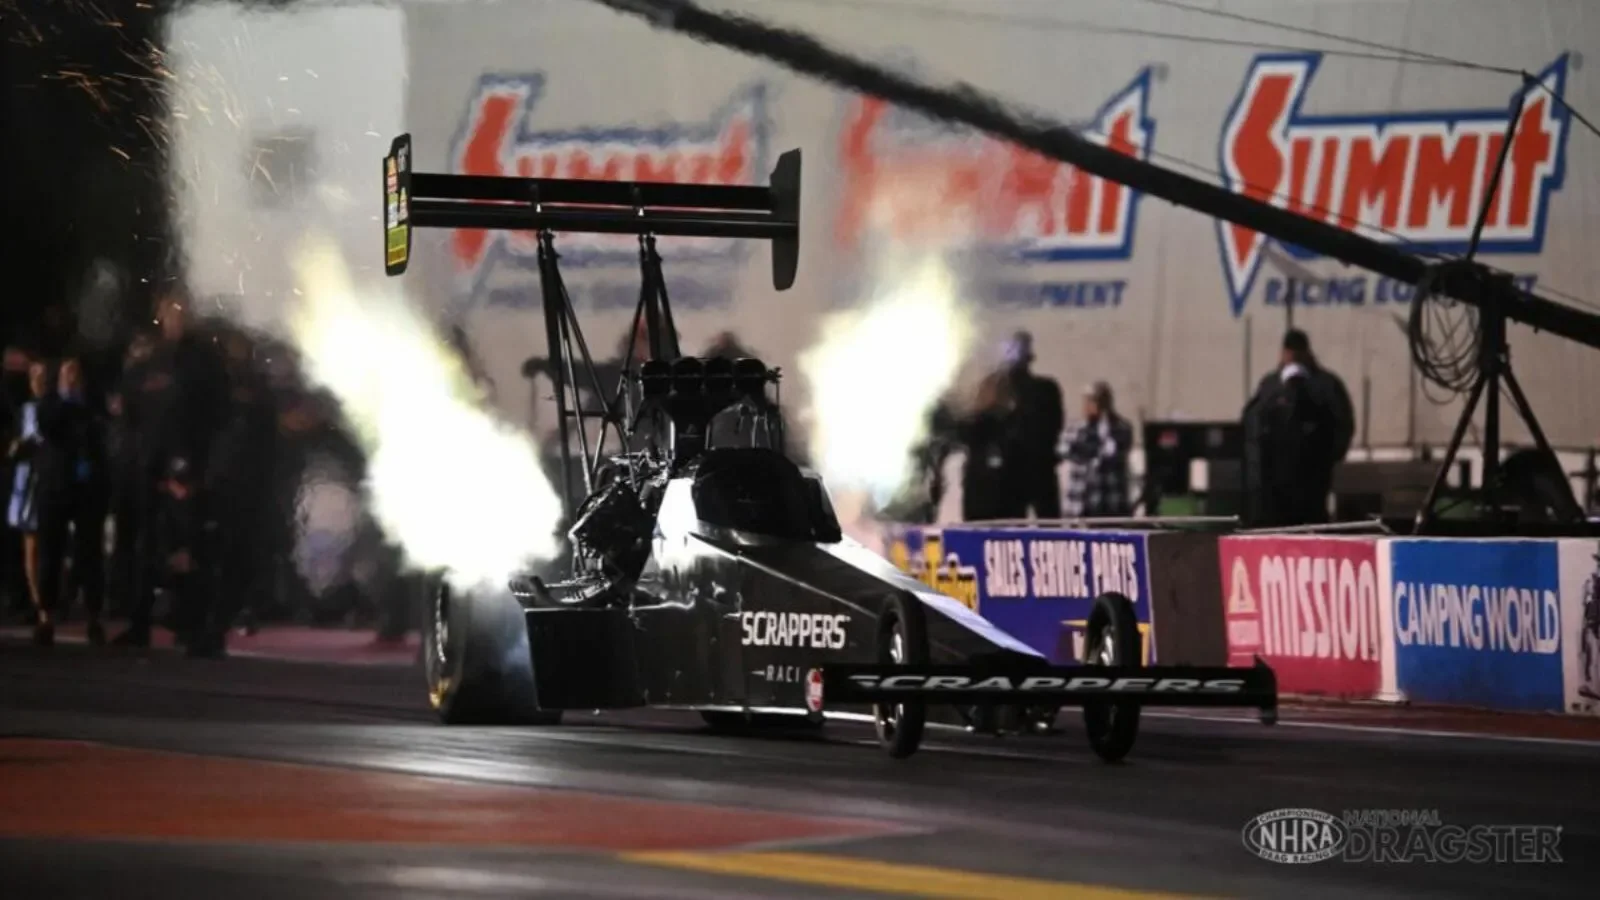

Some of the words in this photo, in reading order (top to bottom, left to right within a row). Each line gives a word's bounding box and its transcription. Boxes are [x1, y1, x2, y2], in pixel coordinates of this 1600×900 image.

[984, 539, 1027, 597] SALES
[1030, 539, 1089, 599] SERVICE
[1091, 541, 1138, 603] PARTS
[742, 611, 846, 650] SCRAPPERS
[1260, 555, 1380, 661] MISSION
[1395, 580, 1483, 650] CAMPING
[1483, 586, 1559, 654] WORLD
[765, 665, 800, 683] RACI
[849, 674, 1246, 693] SCRAPPERS
